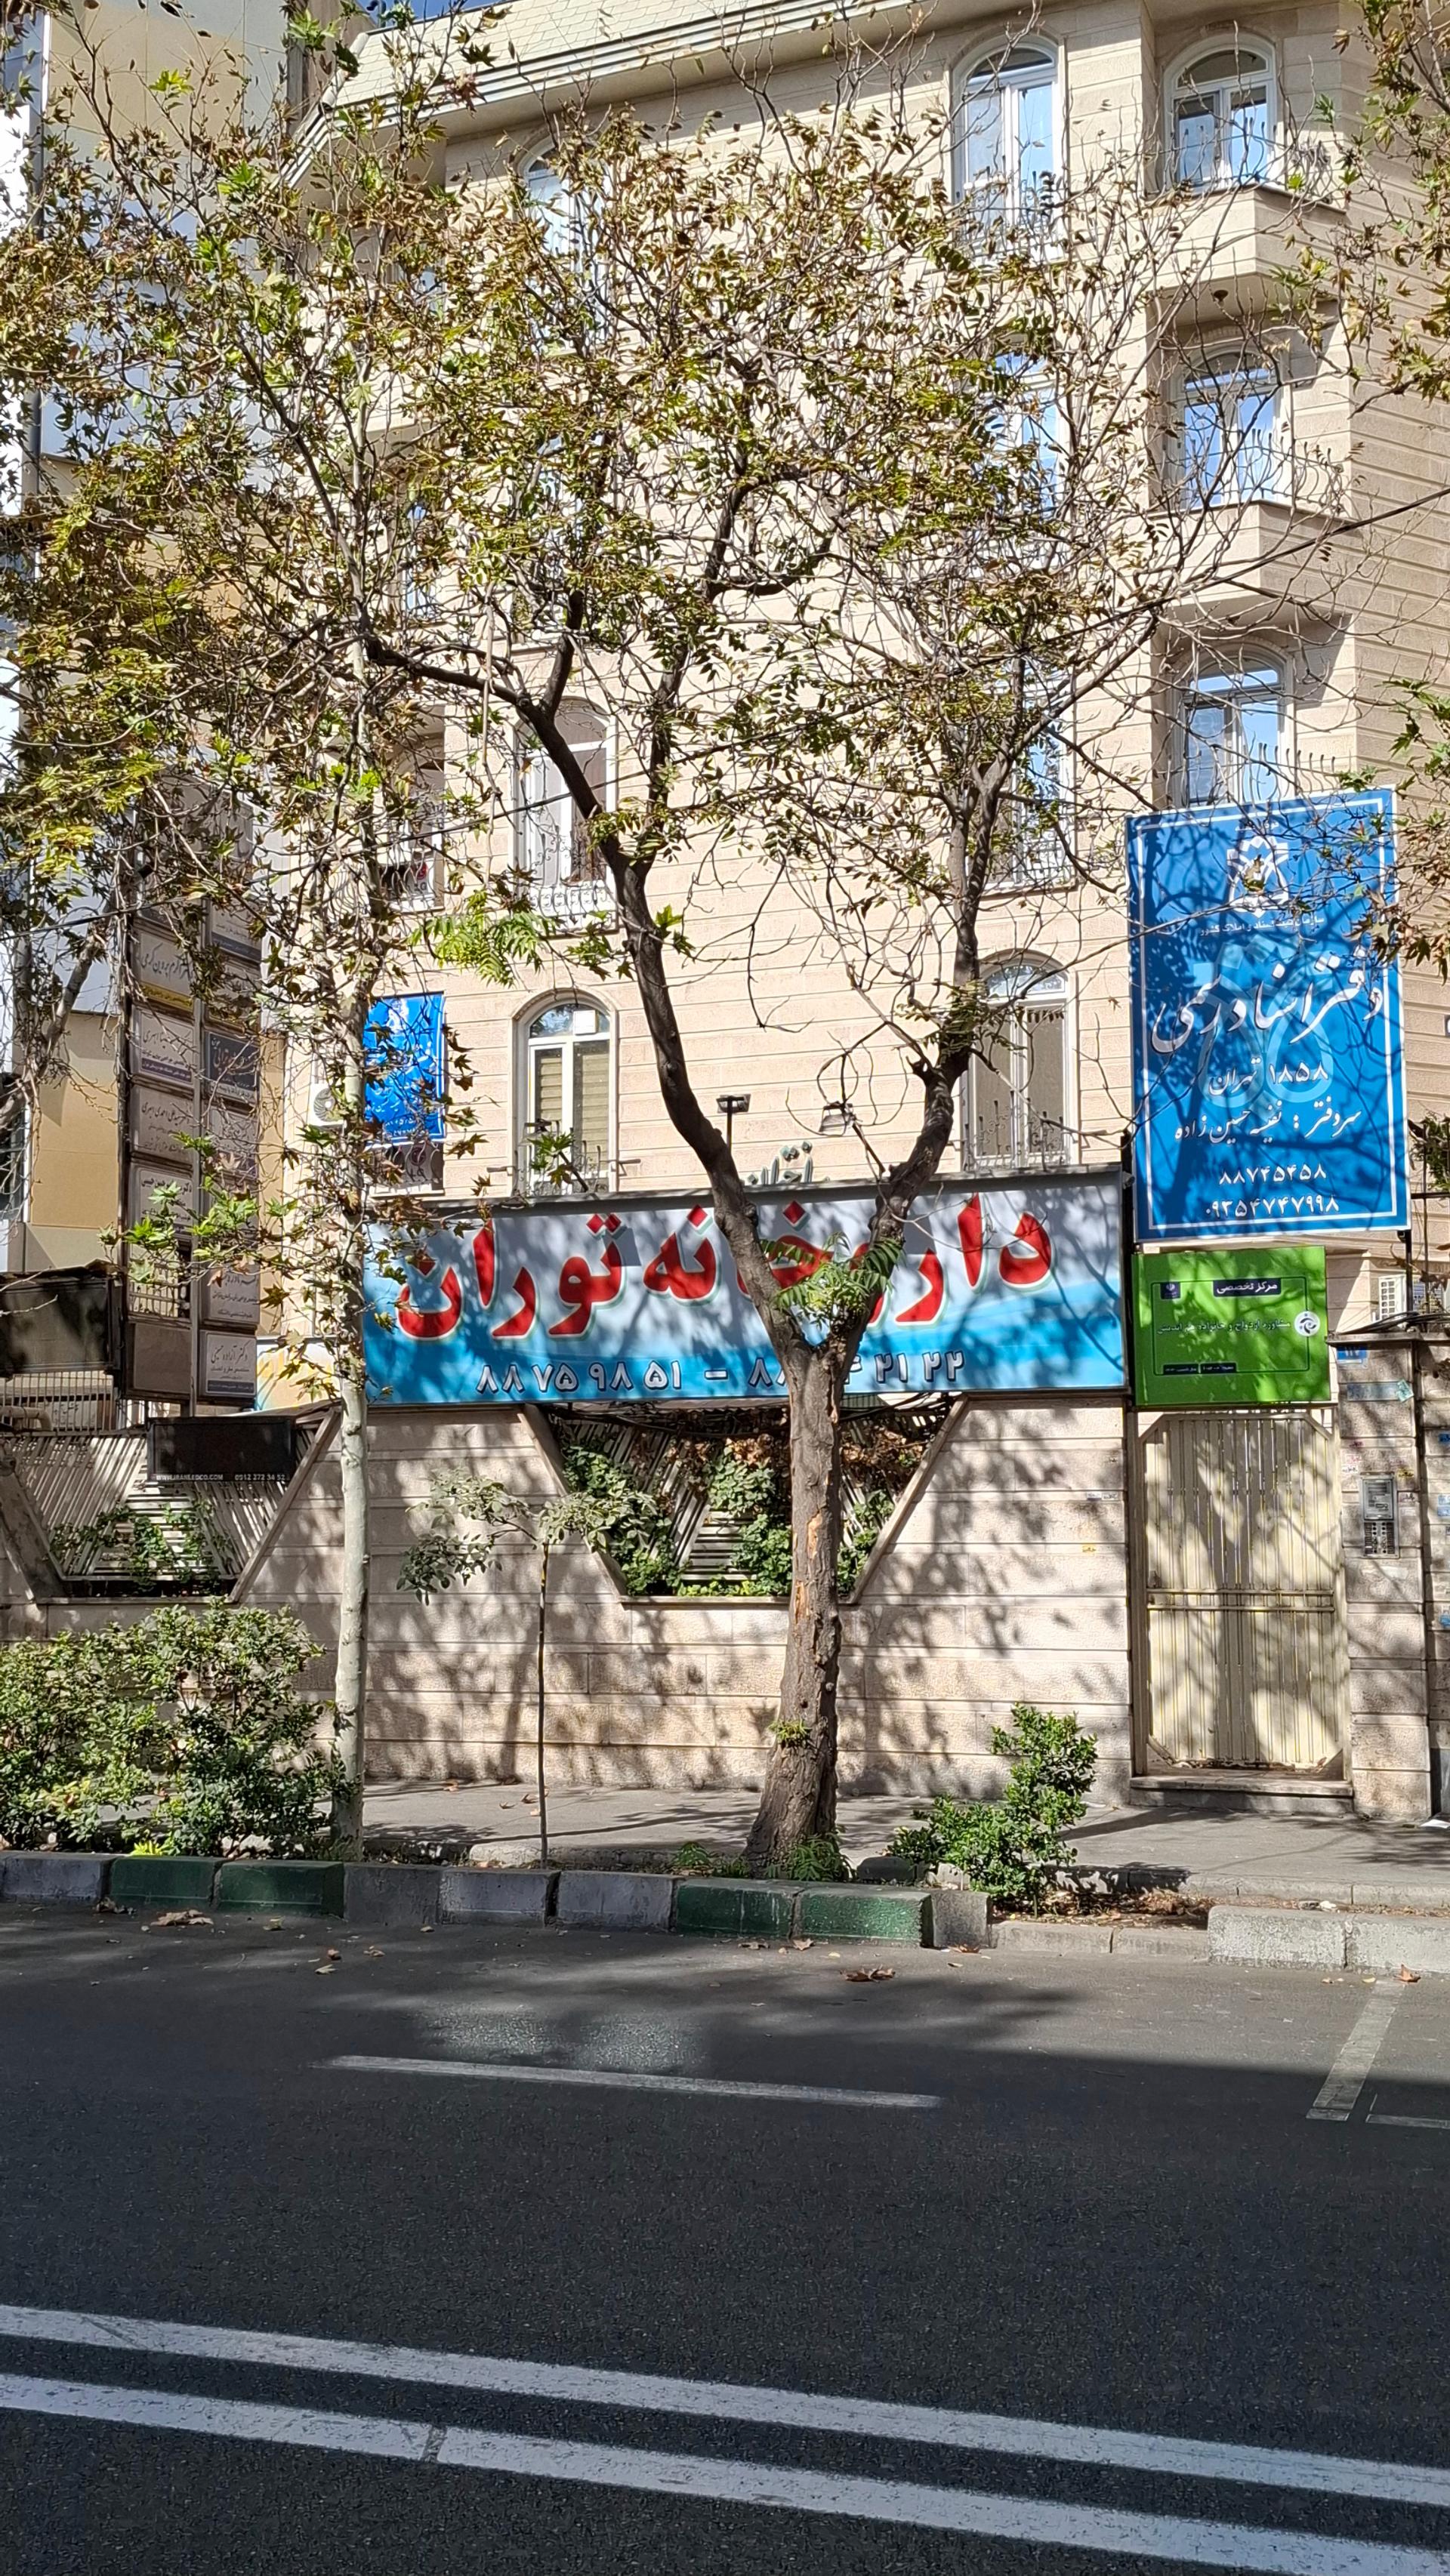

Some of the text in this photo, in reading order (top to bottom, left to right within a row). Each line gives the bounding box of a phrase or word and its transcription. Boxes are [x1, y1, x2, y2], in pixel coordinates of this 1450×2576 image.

[1151, 944, 1384, 1053] دفتر اسناد رسمی
[1209, 1057, 1329, 1095] ۱۸۵۸ تهران
[1250, 1100, 1282, 1143] نفیسه
[1219, 1163, 1327, 1185] ۸۸۷۴۵۴۵۸
[1206, 1194, 1339, 1218] ۰۹۳۵۴۷۴۷۹۹۸
[396, 1212, 626, 1342] توران
[1217, 1280, 1278, 1294] مرکز تخصصی
[1235, 1318, 1260, 1331] ازدواج
[1262, 1319, 1291, 1330] مشاوره
